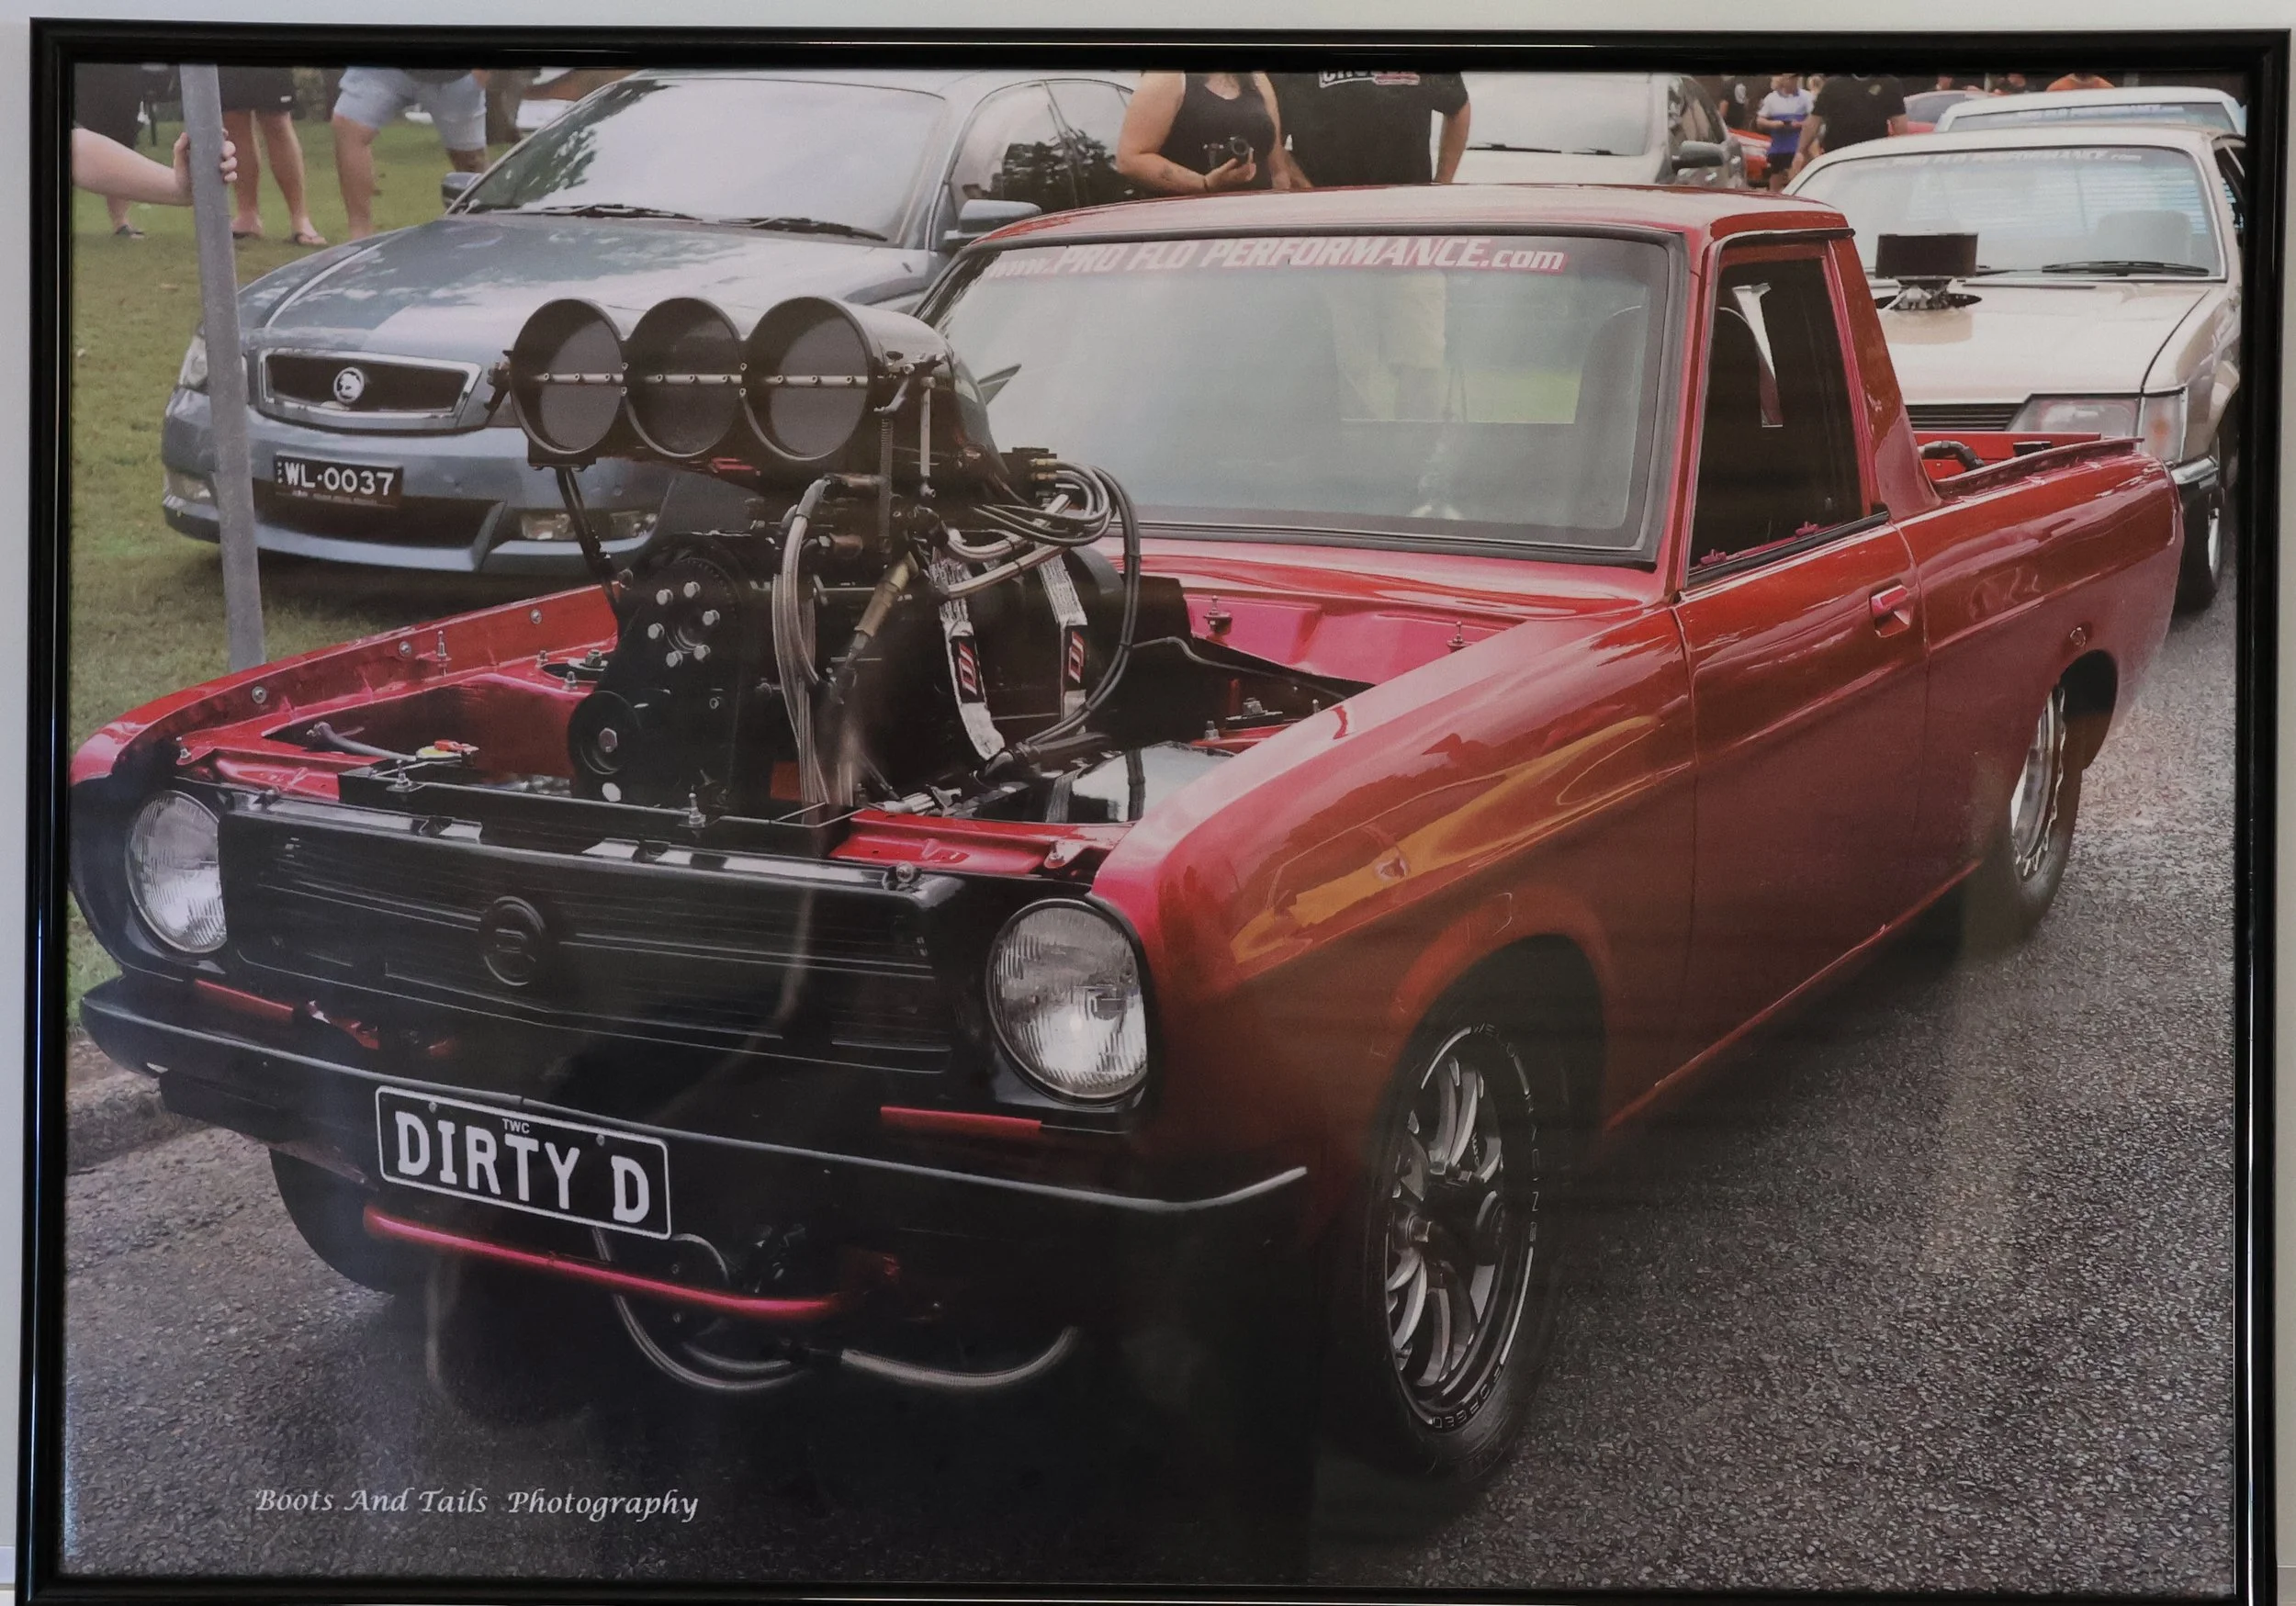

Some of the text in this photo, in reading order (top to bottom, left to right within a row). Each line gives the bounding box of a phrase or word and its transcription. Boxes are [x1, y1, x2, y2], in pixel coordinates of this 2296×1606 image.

[1124, 241, 1198, 272] FLO
[1199, 237, 1566, 271] PERFORMANCE.com
[501, 1117, 531, 1135] TWC
[395, 1110, 650, 1224] DIRTY D
